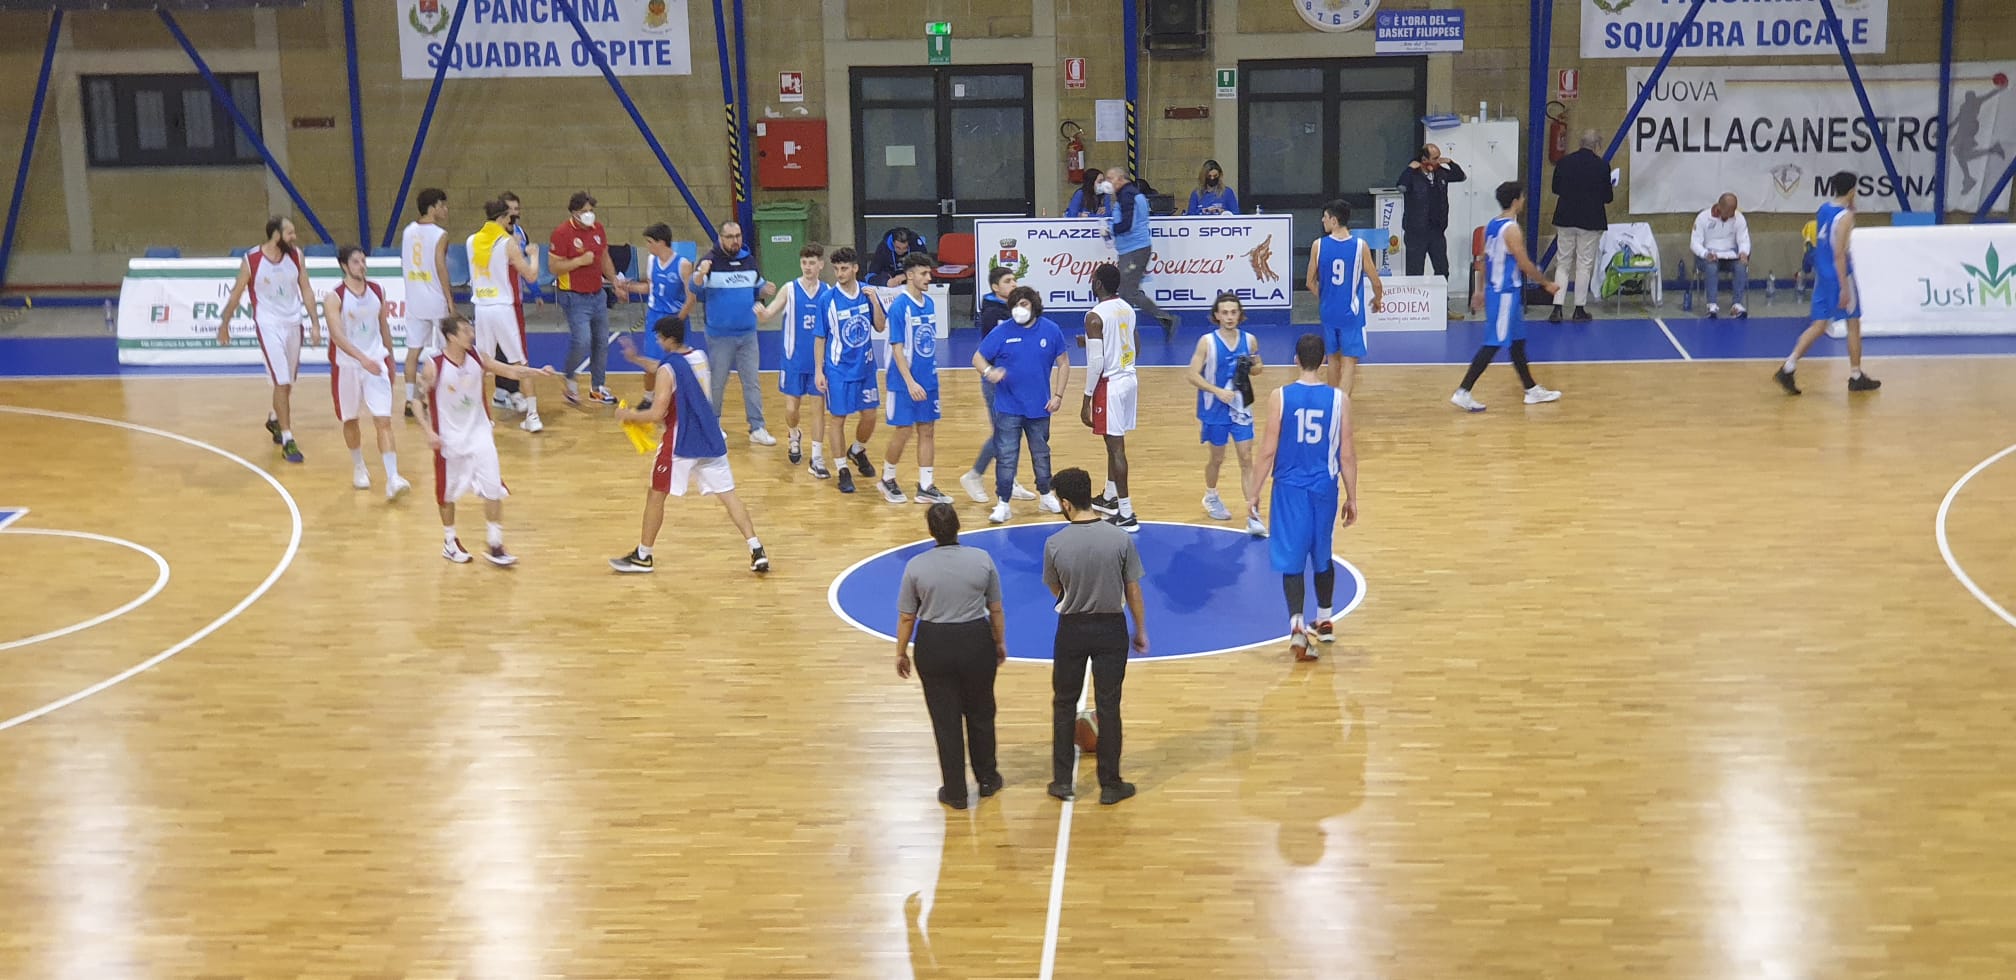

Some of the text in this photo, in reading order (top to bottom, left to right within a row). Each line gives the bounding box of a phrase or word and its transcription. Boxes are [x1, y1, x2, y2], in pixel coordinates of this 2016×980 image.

[1332, 13, 1341, 25] 6
[1401, 15, 1427, 26] L'ORA
[1429, 15, 1446, 26] DEL
[1379, 26, 1460, 38] BASKET FILIPPESE
[1604, 21, 1745, 52] SQUADRA
[427, 40, 672, 71] SQUADRA OSPITE
[1636, 80, 1719, 102] NUOVA
[1149, 227, 1190, 238] ELLO
[1199, 226, 1252, 237] SPORT
[1331, 258, 1345, 286] 9
[1155, 288, 1207, 301] DEL
[1294, 408, 1324, 444] 15
